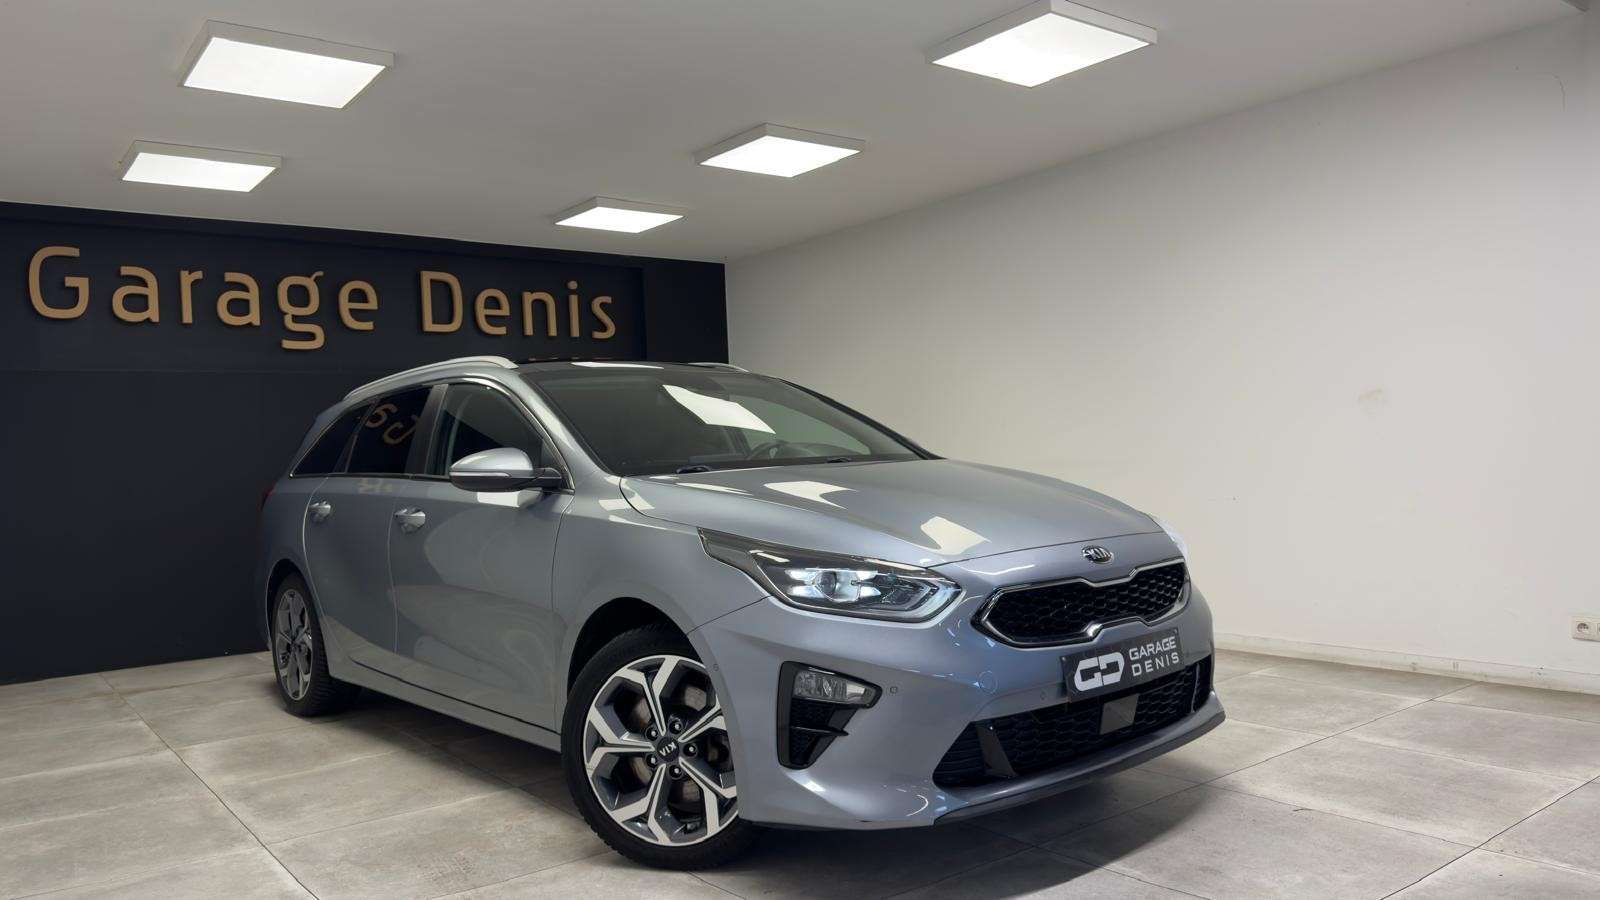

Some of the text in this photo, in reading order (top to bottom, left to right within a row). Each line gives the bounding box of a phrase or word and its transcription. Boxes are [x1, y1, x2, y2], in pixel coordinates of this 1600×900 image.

[28, 246, 617, 349] Garage Denis
[1083, 547, 1112, 562] KIA
[1128, 636, 1177, 660] GARAGE
[1131, 652, 1180, 676] DENIS
[659, 741, 677, 756] KIA
